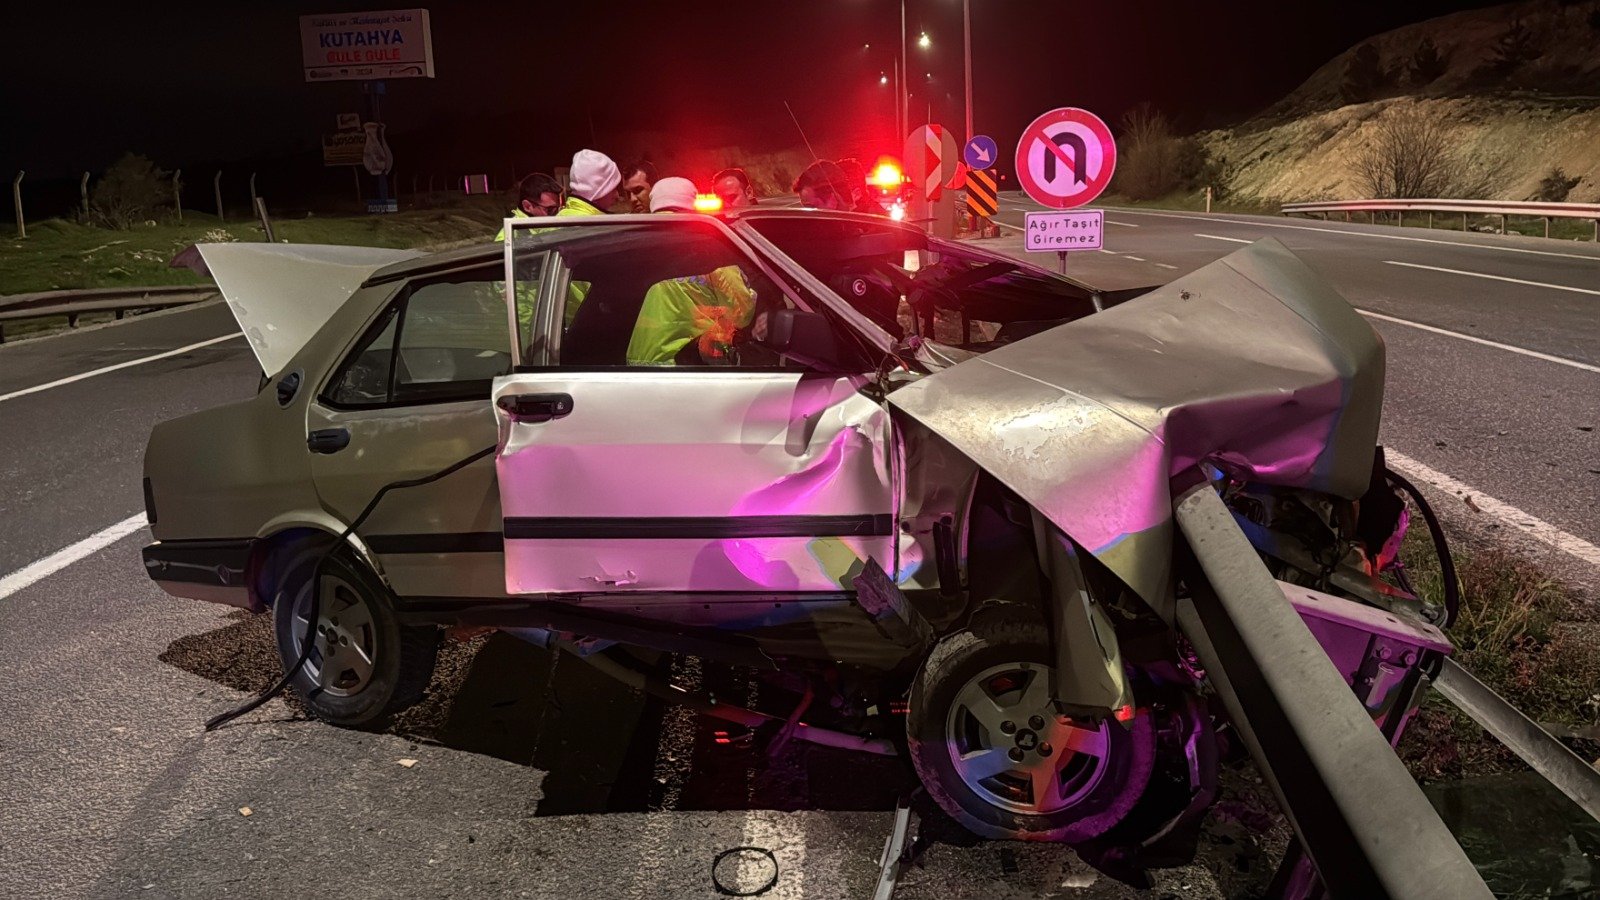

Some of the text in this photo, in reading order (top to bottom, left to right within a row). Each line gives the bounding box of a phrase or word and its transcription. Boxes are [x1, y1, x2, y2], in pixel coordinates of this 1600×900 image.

[1029, 218, 1099, 231] Ağır Taşıt
[1033, 234, 1095, 244] Giremez
